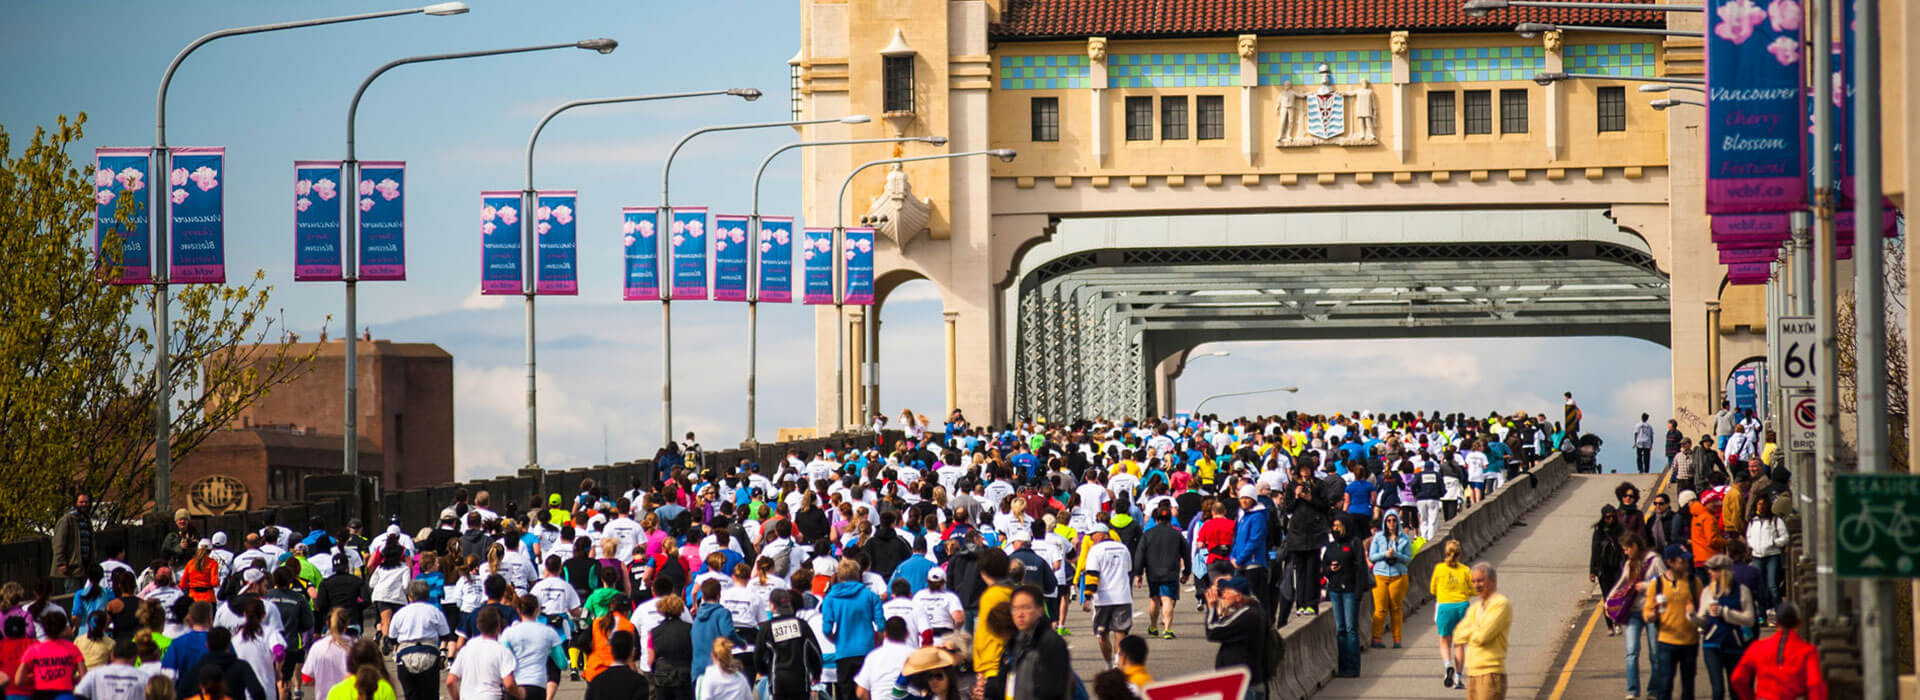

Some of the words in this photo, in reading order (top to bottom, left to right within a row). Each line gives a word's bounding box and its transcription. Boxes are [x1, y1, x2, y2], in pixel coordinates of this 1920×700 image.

[1710, 87, 1797, 101] Vancouver
[1725, 108, 1781, 133] Cherry
[1721, 133, 1785, 151] Blossom
[1727, 183, 1784, 198] vcbf.ca
